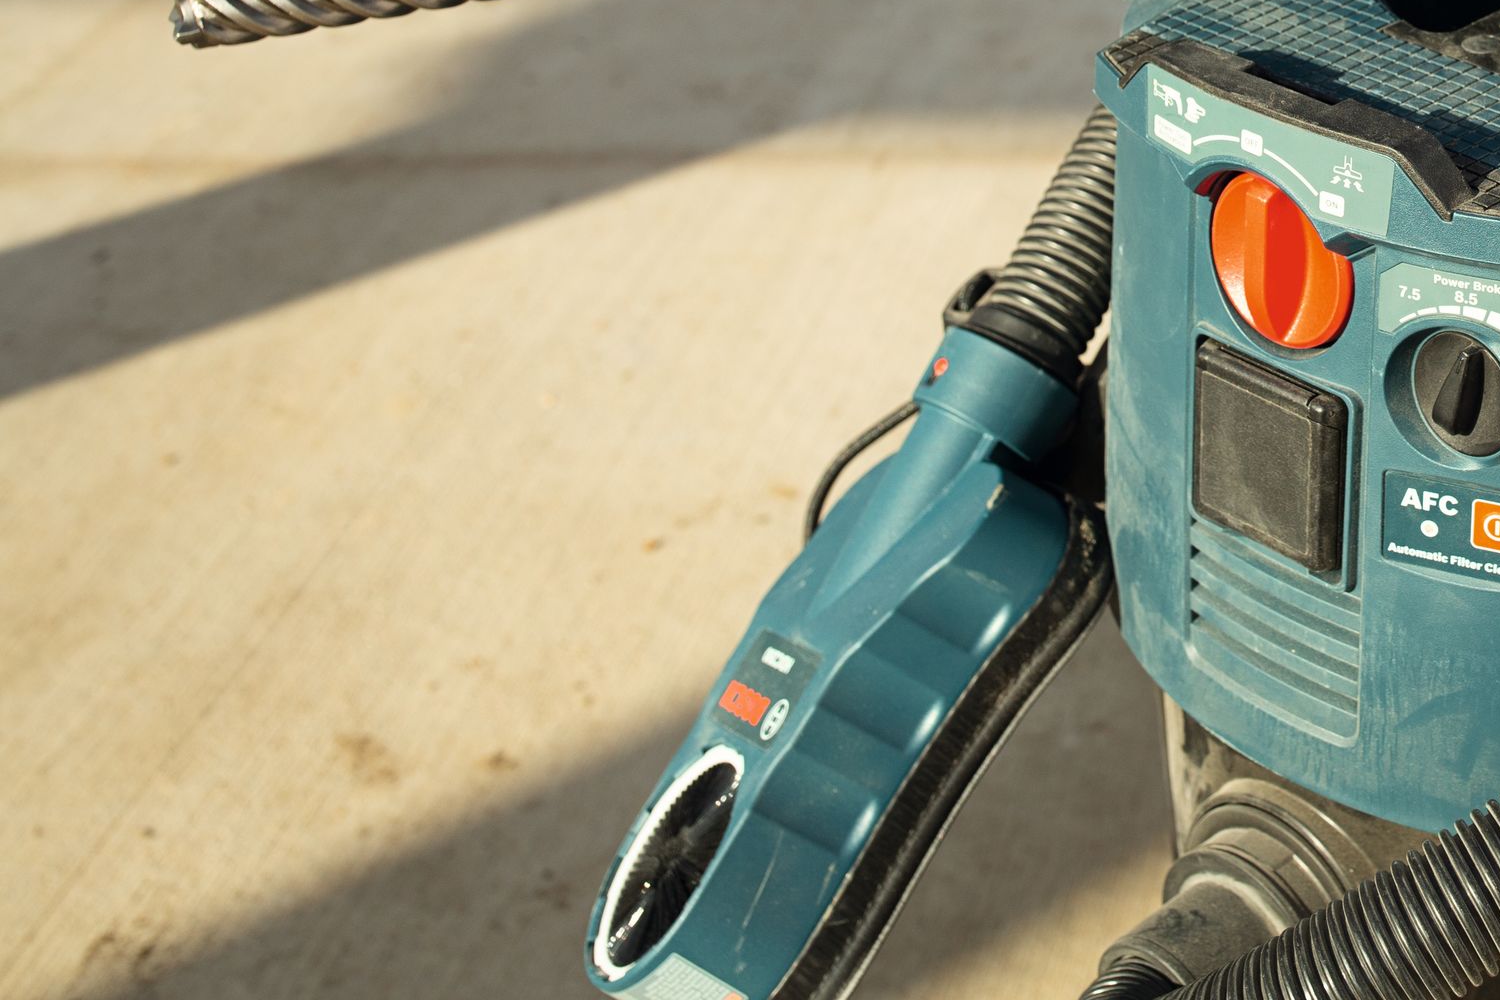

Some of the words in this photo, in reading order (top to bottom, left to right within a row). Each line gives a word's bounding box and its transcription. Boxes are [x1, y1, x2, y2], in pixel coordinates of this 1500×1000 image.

[1433, 274, 1470, 289] Power
[1398, 284, 1421, 301] 7.5
[1454, 291, 1478, 306] 8.5
[1400, 487, 1459, 516] AFC
[1387, 541, 1448, 564] Automatic
[1450, 555, 1484, 571] Filter
